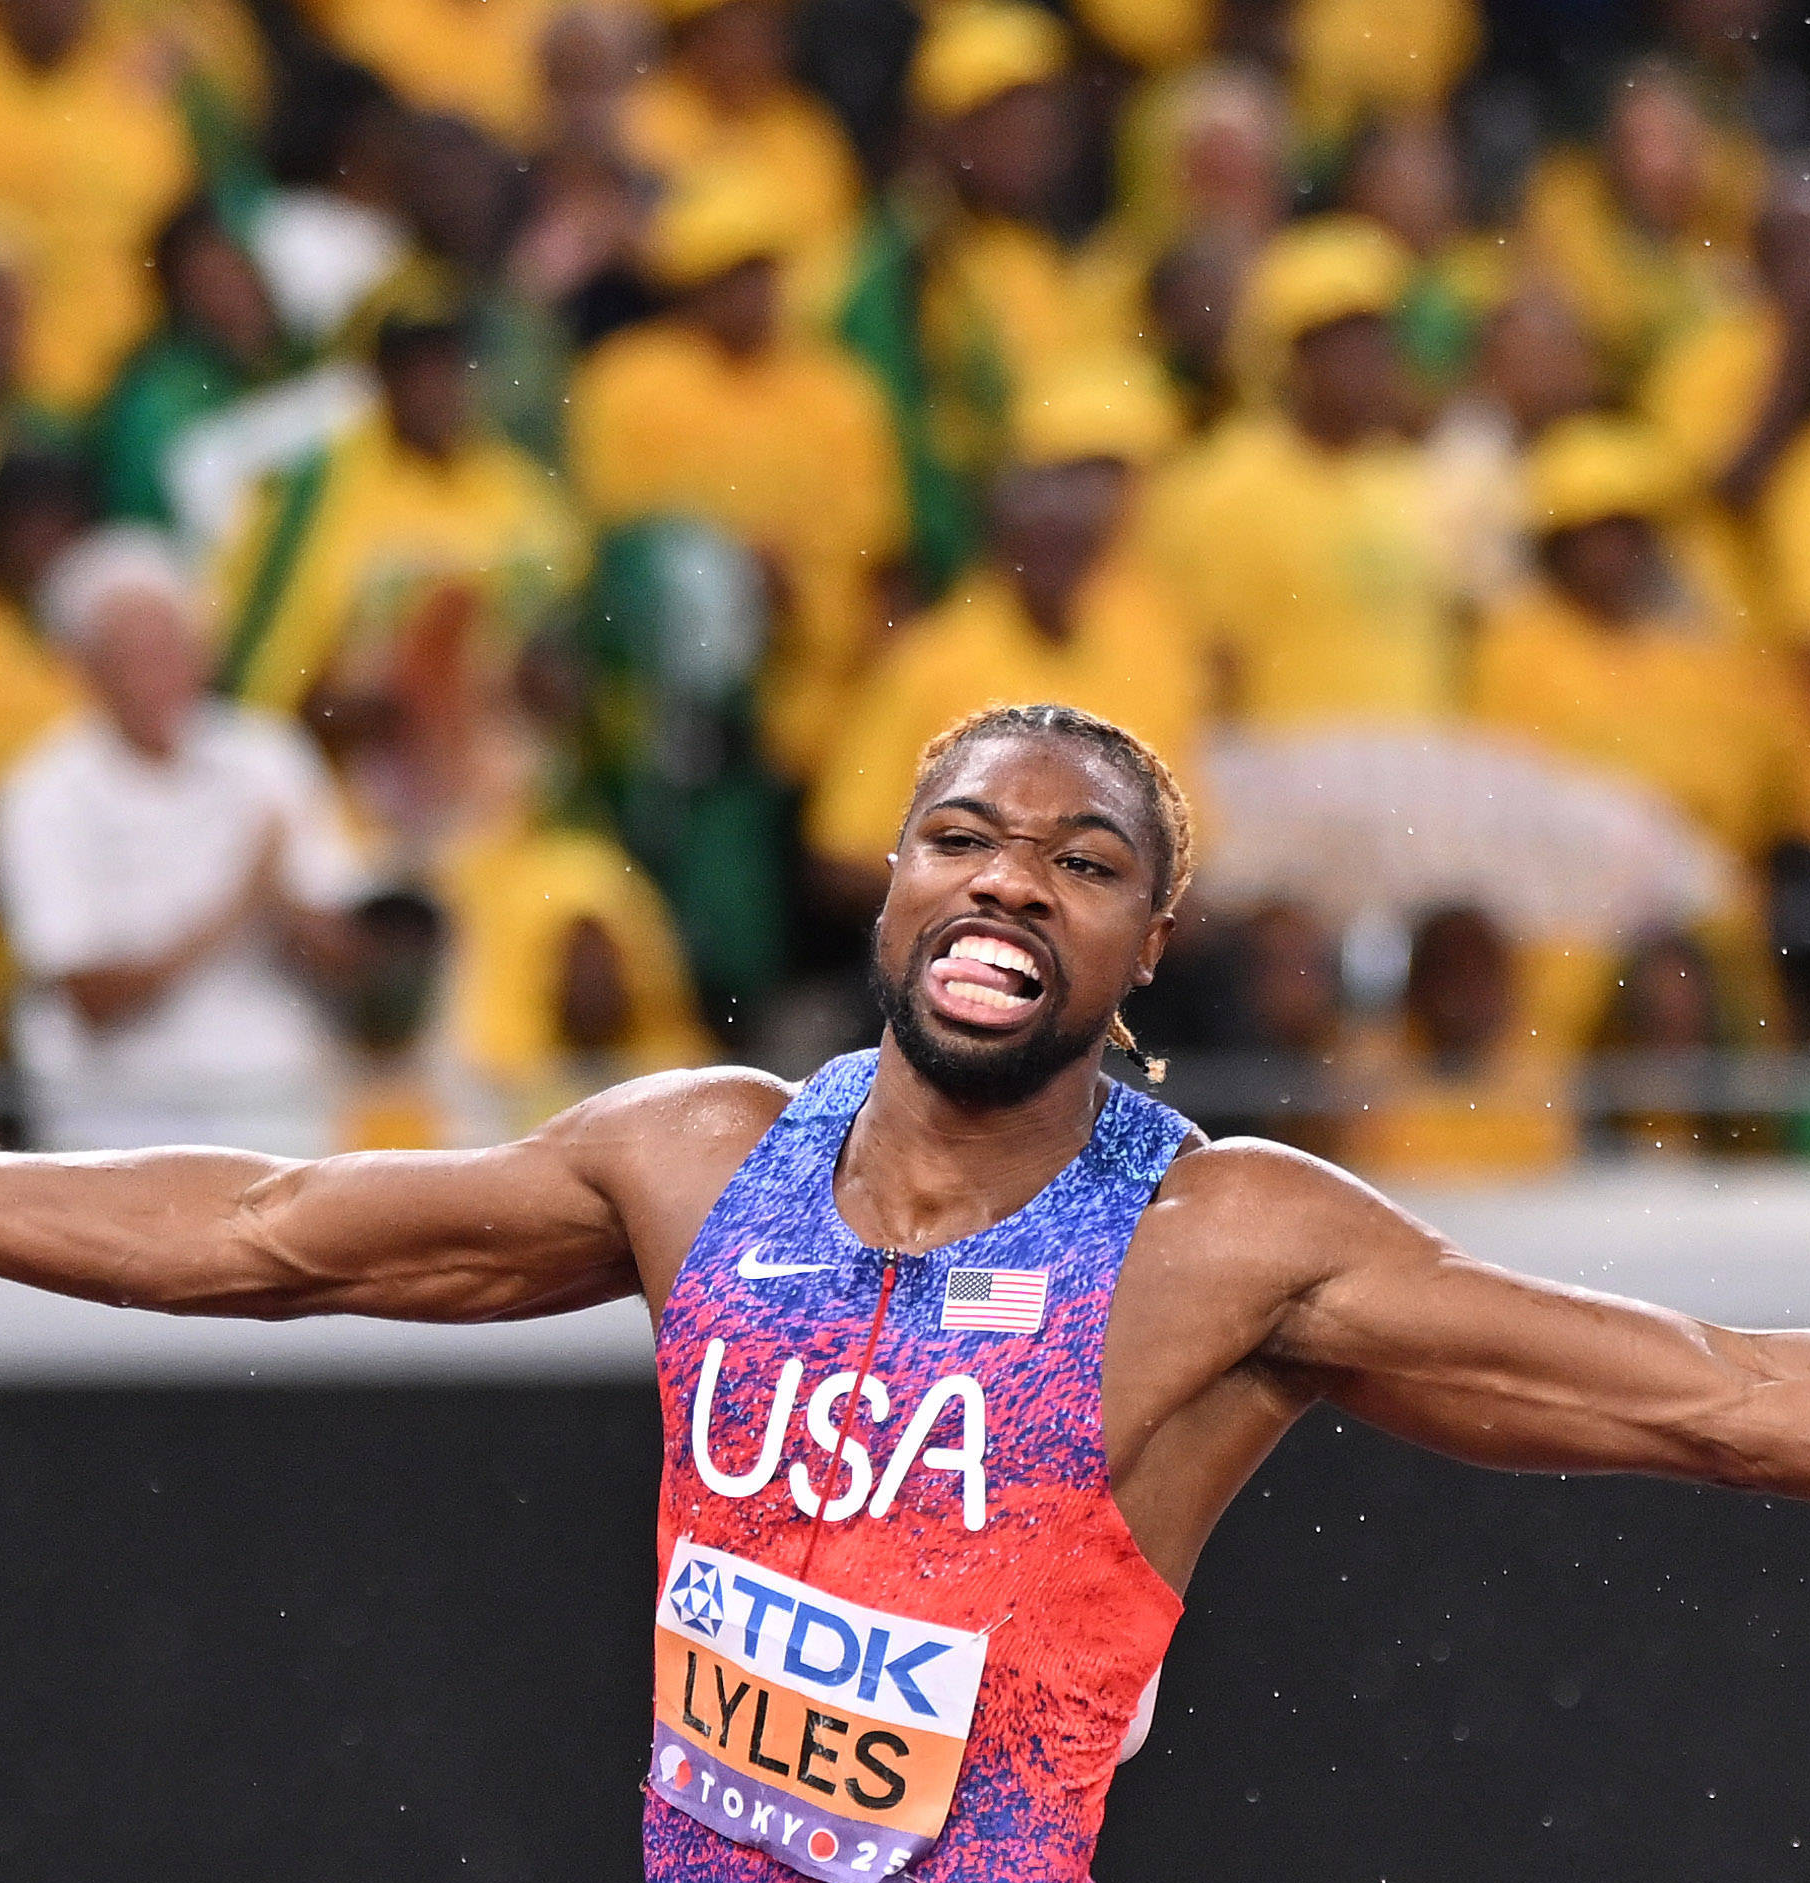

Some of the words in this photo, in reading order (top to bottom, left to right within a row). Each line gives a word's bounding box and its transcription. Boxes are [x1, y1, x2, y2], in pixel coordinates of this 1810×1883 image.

[691, 1338, 986, 1532] USA
[732, 1575, 954, 1720] TDK
[682, 1651, 910, 1810] LYLES
